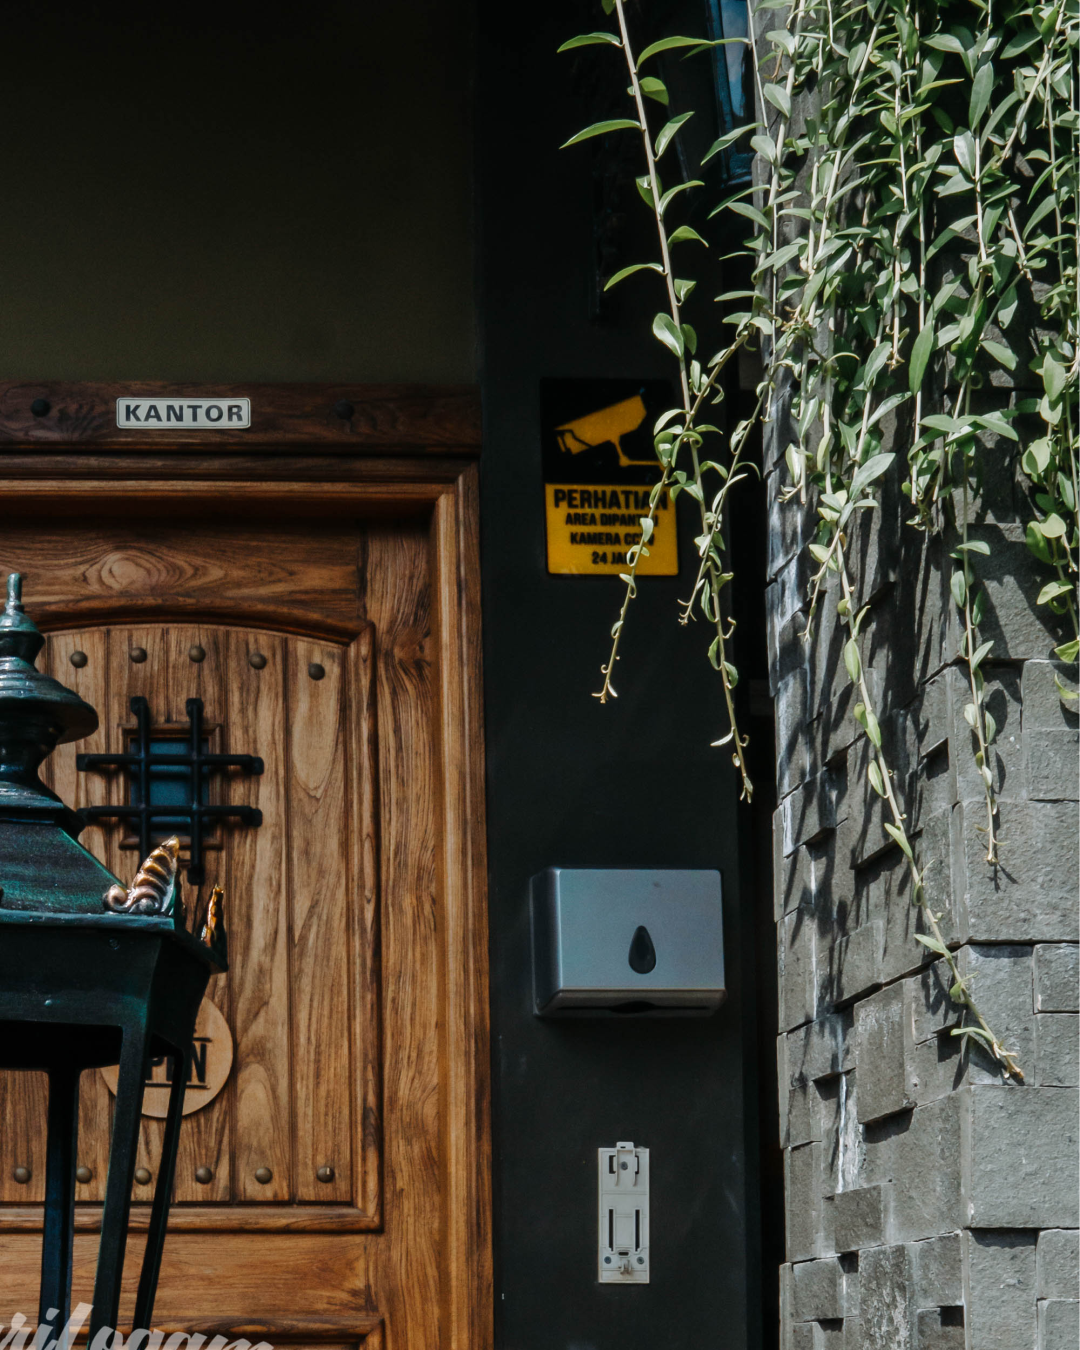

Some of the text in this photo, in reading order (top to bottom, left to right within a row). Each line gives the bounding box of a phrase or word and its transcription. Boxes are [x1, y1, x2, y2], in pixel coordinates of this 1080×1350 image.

[125, 404, 243, 423] KANTOR
[553, 488, 668, 510] PERHATIAN
[565, 513, 659, 528] AREA DIPANT
[570, 532, 655, 546] KAMERA CCV
[592, 551, 608, 565] 24
